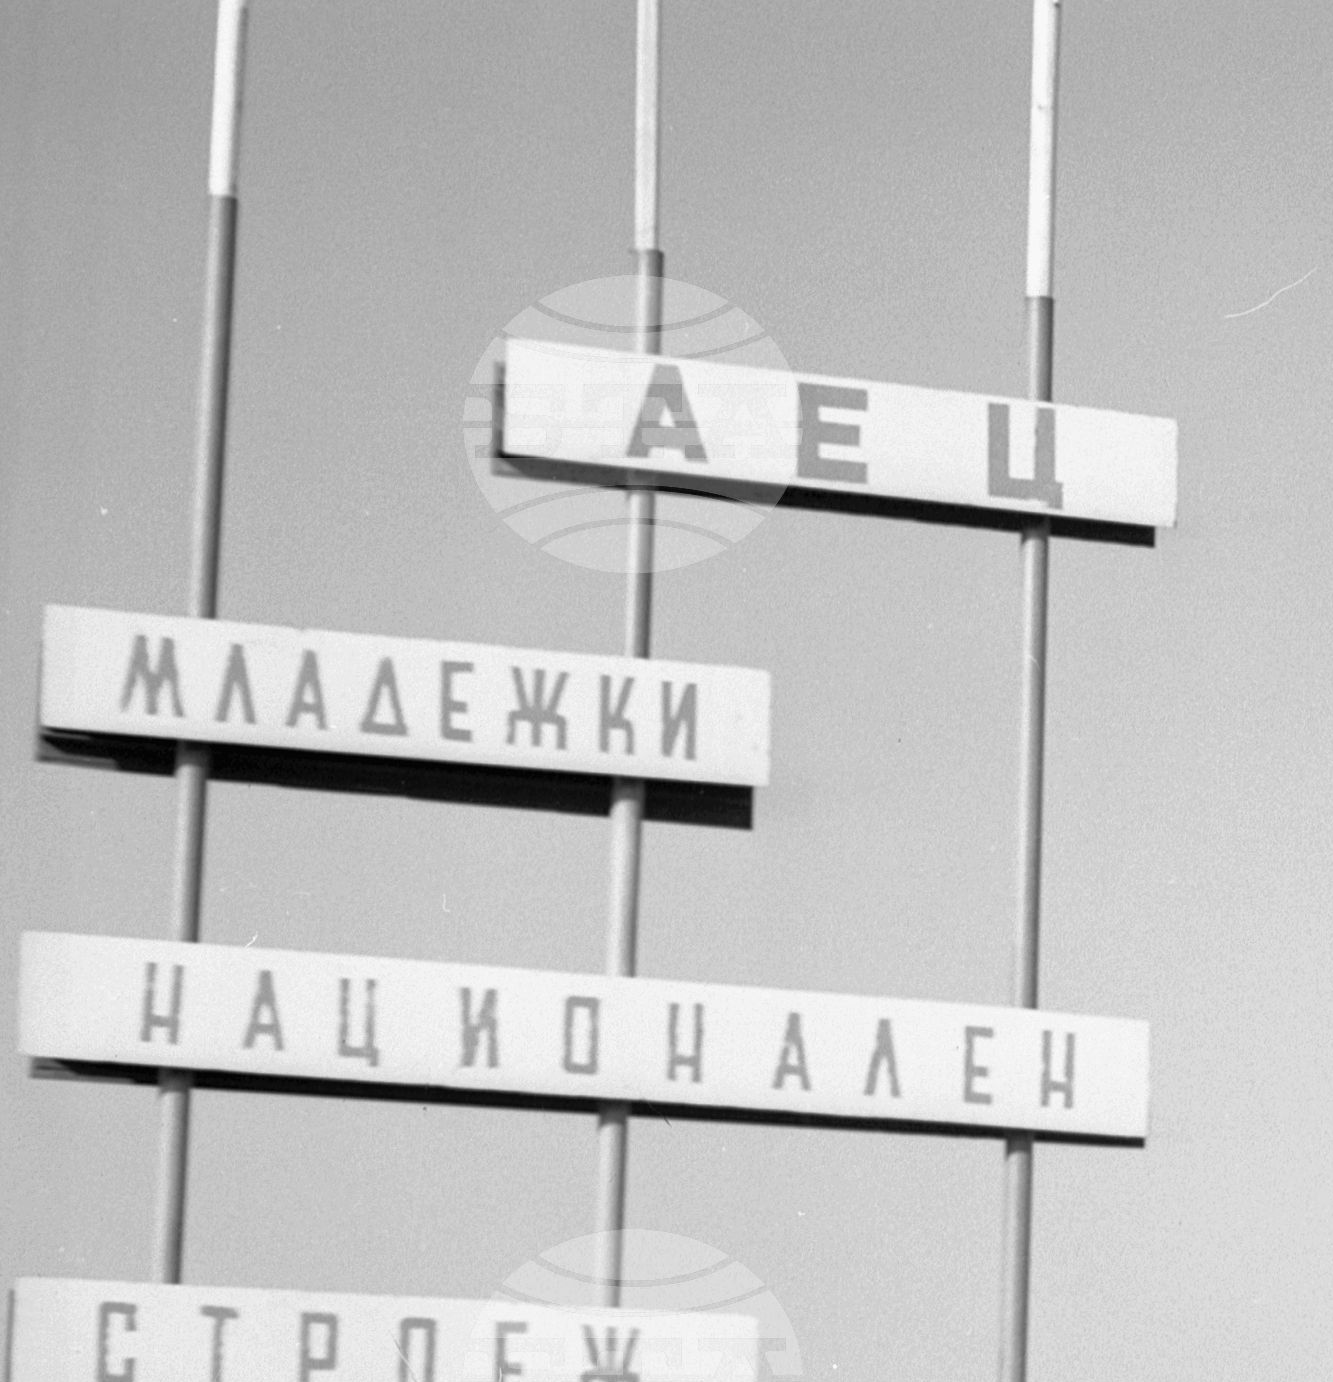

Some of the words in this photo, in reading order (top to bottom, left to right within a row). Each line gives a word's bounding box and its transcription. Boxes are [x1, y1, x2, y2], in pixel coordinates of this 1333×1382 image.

[625, 362, 1064, 510] АЕЦ
[118, 633, 700, 761] МЛАДЕЖКИ
[138, 960, 1077, 1110] НАЦИОНАЛЕН
